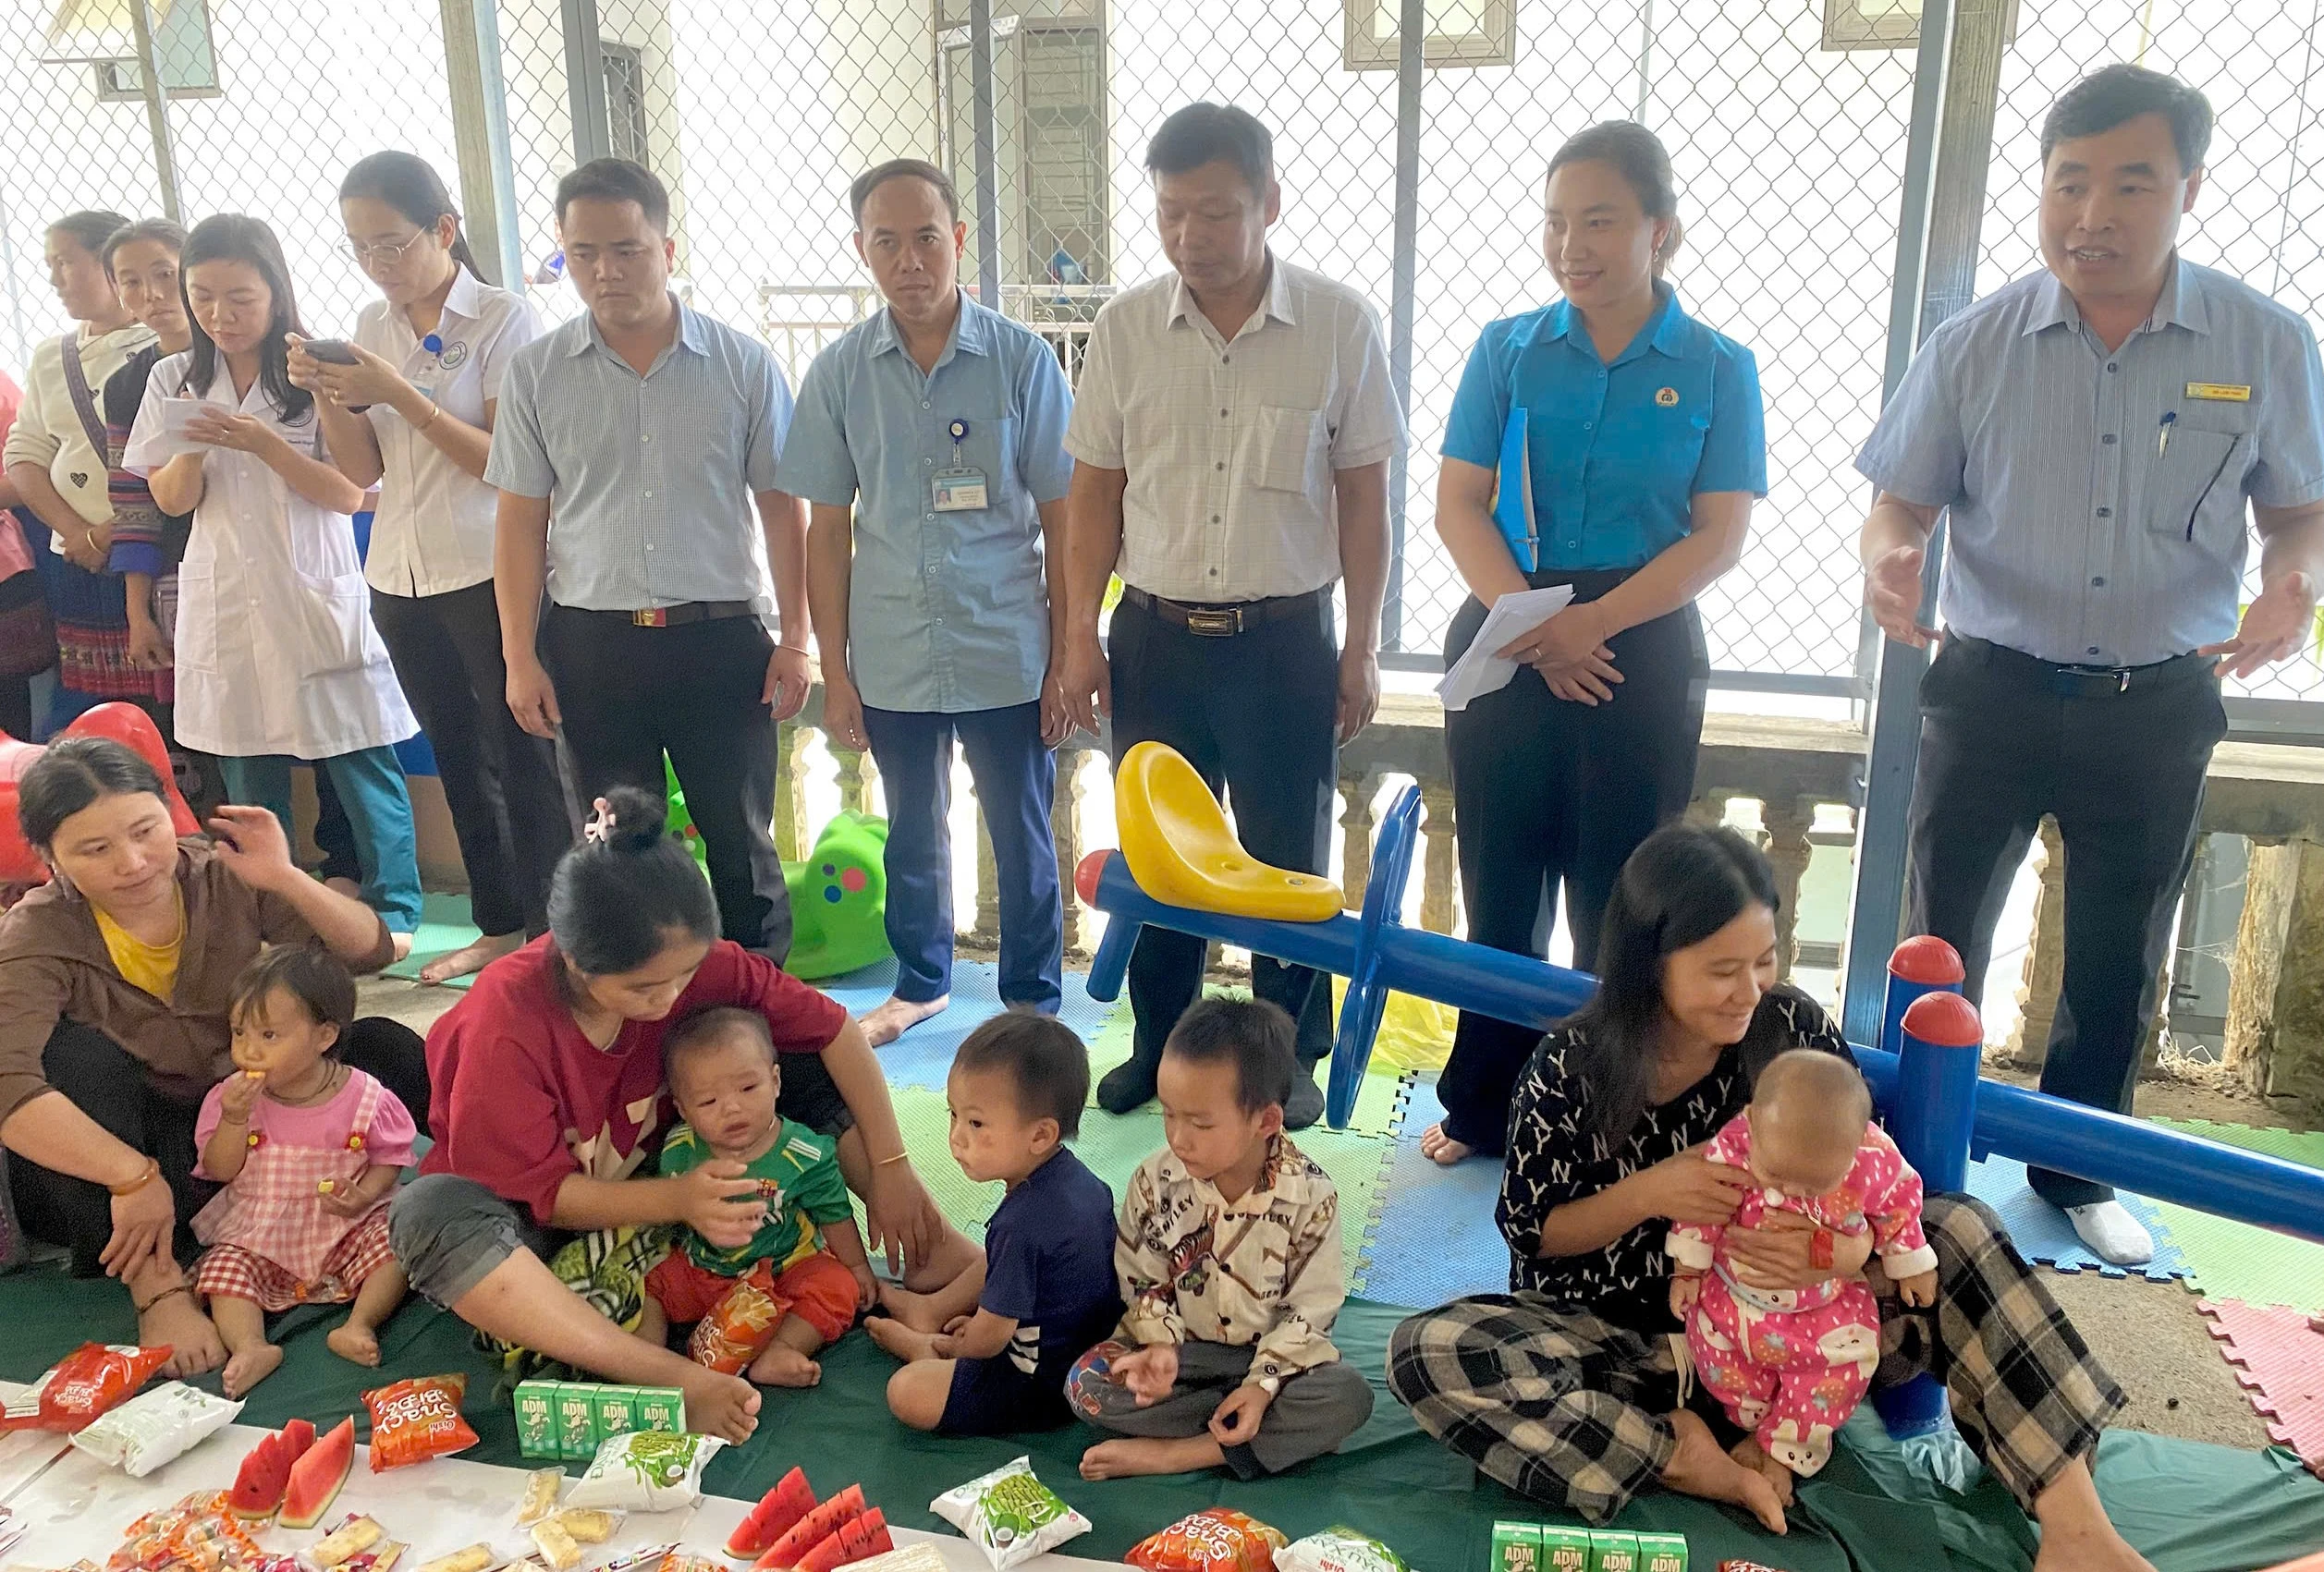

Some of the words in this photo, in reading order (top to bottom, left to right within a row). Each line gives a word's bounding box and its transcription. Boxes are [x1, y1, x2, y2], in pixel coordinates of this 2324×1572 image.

[522, 1399, 547, 1414] ADM
[562, 1402, 587, 1417] ADM
[603, 1405, 629, 1419] ADM
[644, 1407, 670, 1421] ADM
[1504, 1546, 1535, 1562] ADM
[1553, 1550, 1583, 1566] ADM
[1602, 1554, 1633, 1570] ADM
[1650, 1558, 1681, 1572] ADM
